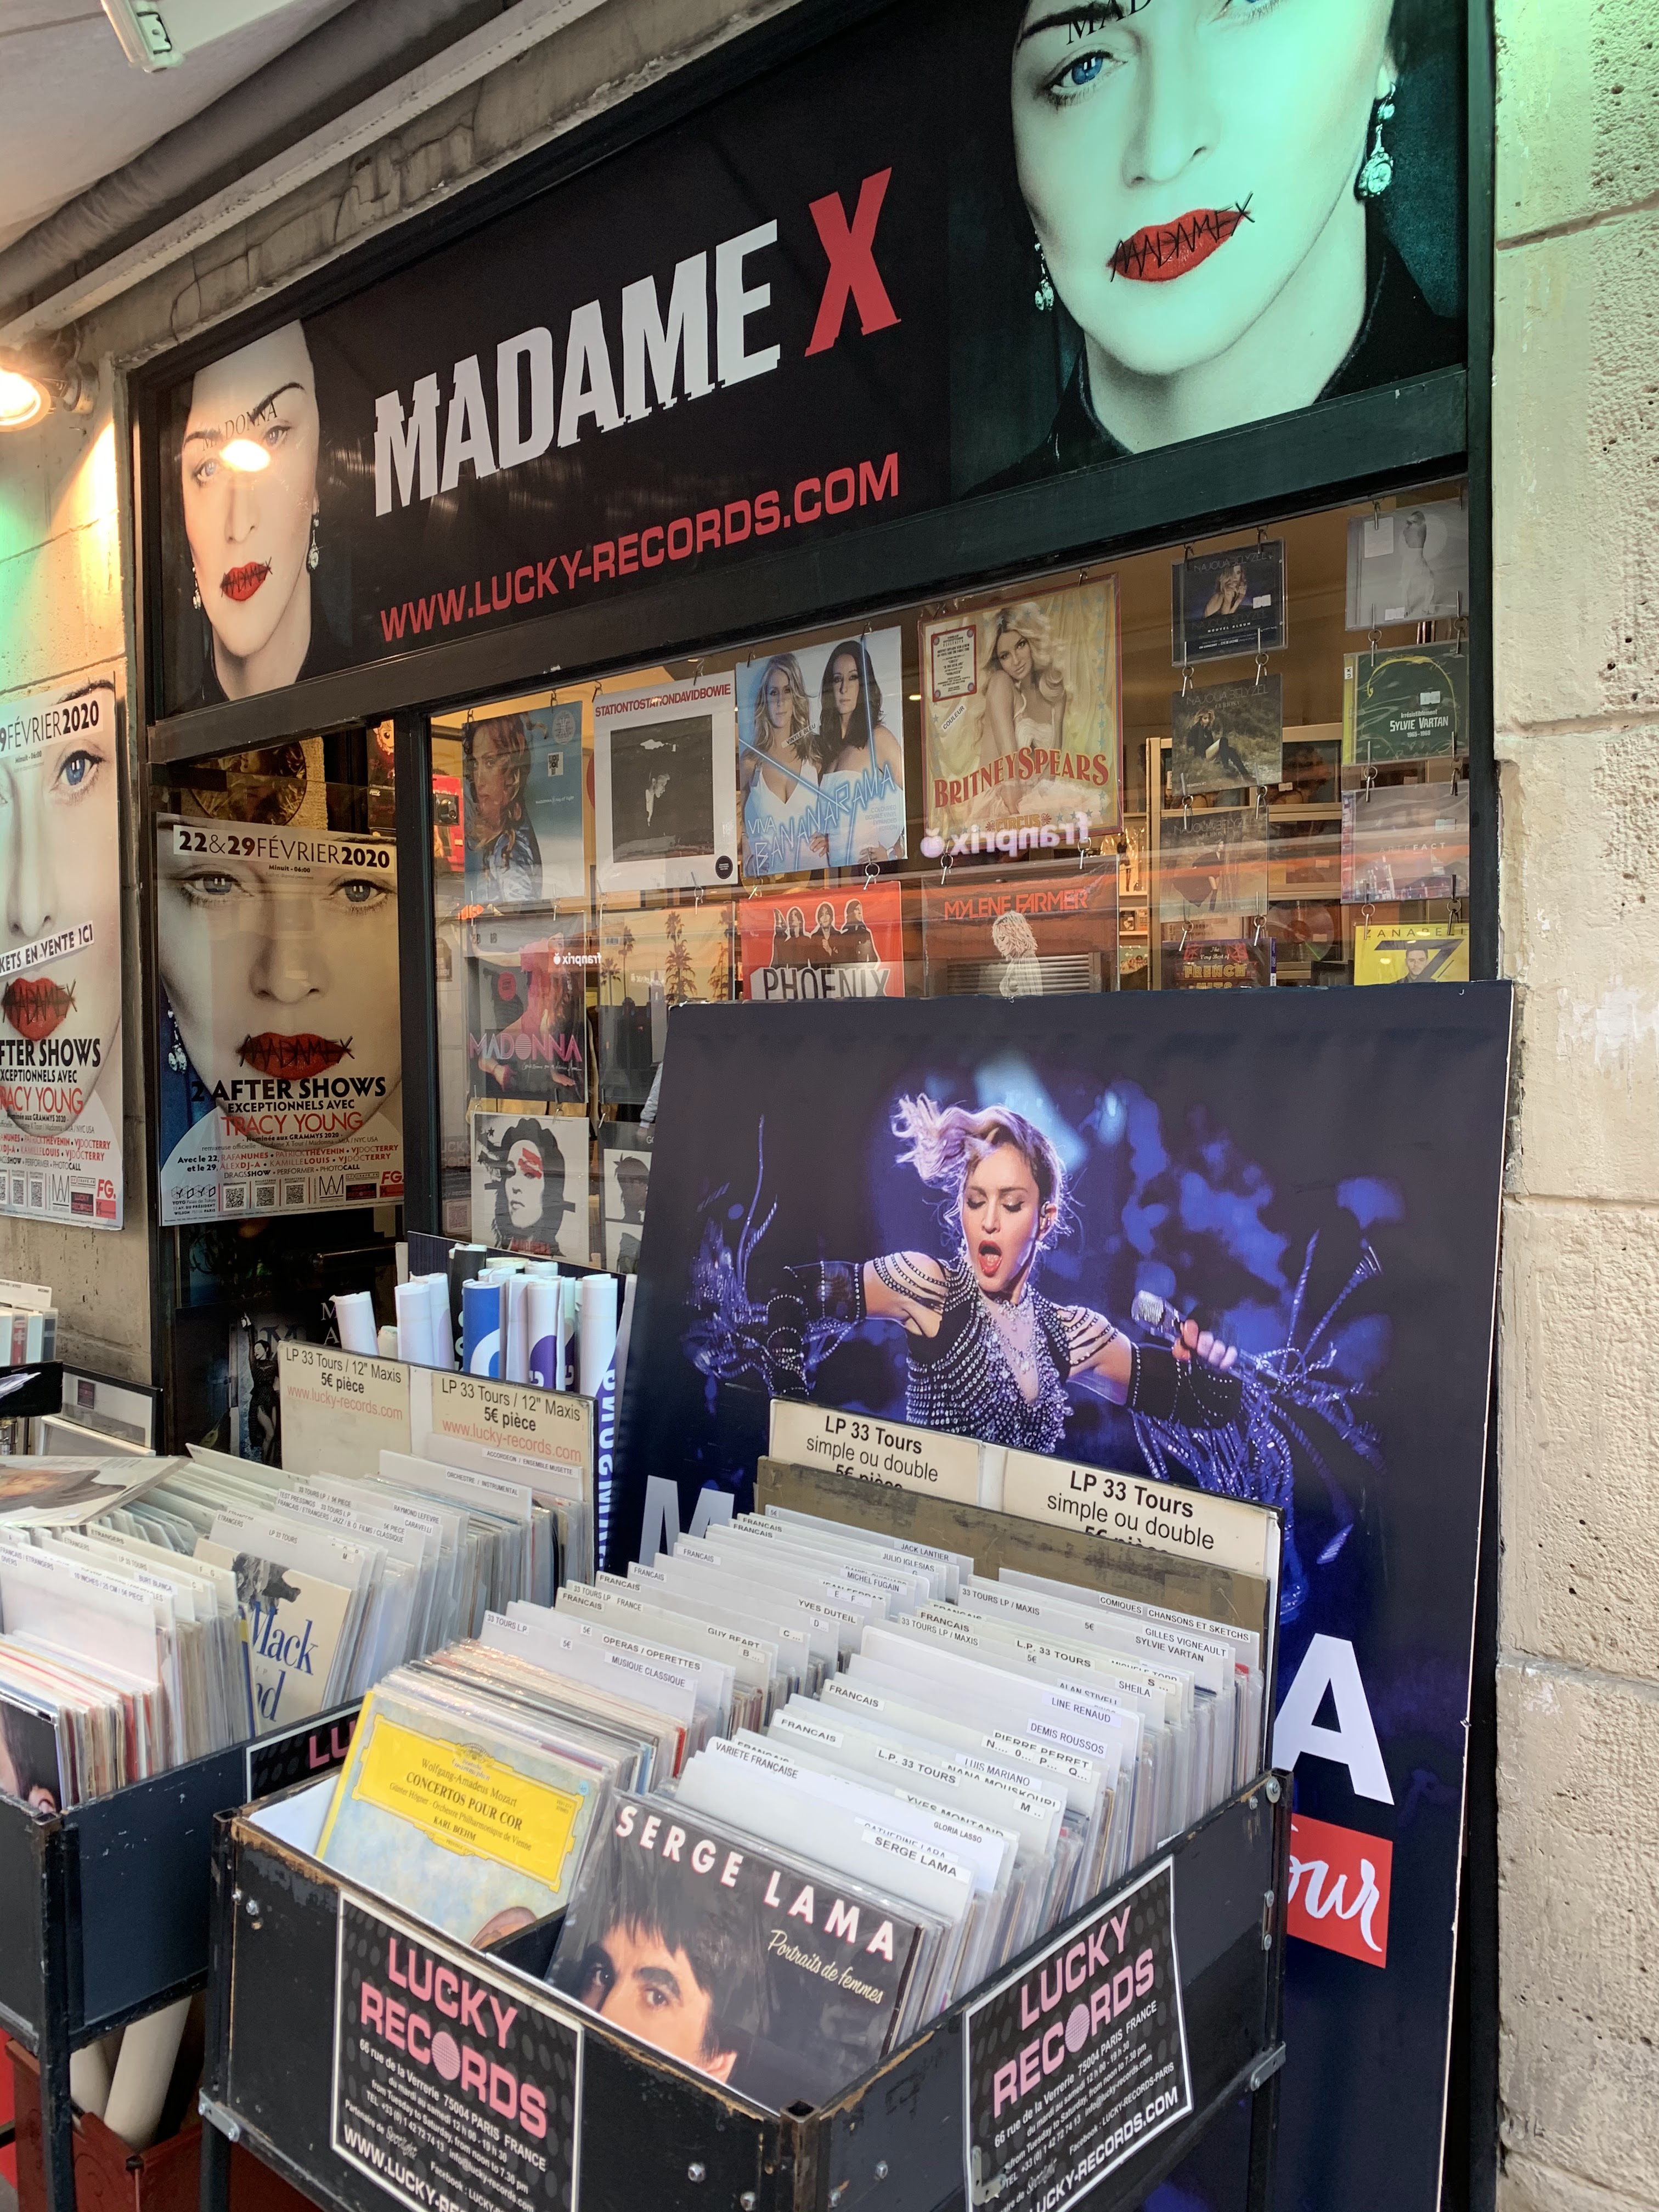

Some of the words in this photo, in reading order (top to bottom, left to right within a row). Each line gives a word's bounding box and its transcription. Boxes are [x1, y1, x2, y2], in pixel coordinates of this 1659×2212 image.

[374, 219, 780, 516] MADAME
[804, 167, 901, 357] X
[380, 452, 899, 642] WWW.LUCKY-RECORDS.COM
[942, 706, 966, 730] COULEUR
[1390, 720, 1416, 732] SYLVIE
[1419, 716, 1449, 729] VARTAN
[786, 731, 804, 744] VINYLE
[803, 724, 816, 735] BLEU
[748, 816, 776, 834] VIVA
[755, 763, 895, 877] BANANARAMA
[945, 895, 1011, 921] MYLENE
[1016, 888, 1088, 913] FARMER
[25, 945, 38, 964] EN
[41, 931, 75, 958] VENTE
[78, 924, 93, 945] ICI
[763, 967, 889, 998] PHOENIX
[1184, 964, 1248, 978] FRENCH
[39, 1039, 101, 1068] SHOWS
[470, 1032, 583, 1062] MADONNA
[57, 1070, 77, 1084] AVEC
[190, 1081, 205, 1103] 2
[211, 1078, 295, 1102] AFTER
[299, 1076, 386, 1098] SHOWS
[35, 1087, 83, 1115] YOUNG
[228, 1100, 324, 1114] EXCEPTIONNELS
[326, 1099, 355, 1110] AVEC
[221, 1114, 288, 1137] TRACY
[292, 1111, 364, 1133] YOUNG
[289, 1132, 323, 1141] GRAMMYS
[285, 1347, 300, 1363] LP
[302, 1350, 314, 1366] 33
[315, 1352, 344, 1373] Tours
[371, 1362, 402, 1384] Maxis
[320, 1373, 335, 1390] 5€
[336, 1375, 365, 1397] pièce
[286, 1383, 403, 1421] www.lucky-records.com
[441, 1378, 457, 1395] LP
[460, 1380, 475, 1400] 33
[477, 1384, 510, 1406] Tours
[544, 1397, 581, 1423] Maxis
[483, 1406, 499, 1425] 5€
[501, 1410, 537, 1434] pièce
[825, 1414, 847, 1435] LP
[850, 1418, 870, 1440] 33
[874, 1426, 923, 1455] Tours
[441, 1418, 583, 1464] www.lucky-records.com
[806, 1436, 855, 1465] simple
[859, 1451, 879, 1468] ou
[883, 1453, 939, 1483] double
[447, 1470, 476, 1485] ORCHESTRE
[481, 1478, 519, 1497] INSTRUMENTAL
[1070, 1470, 1097, 1494] LP
[1102, 1478, 1127, 1502] 33
[1133, 1485, 1195, 1519] Tours
[1047, 1492, 1109, 1523] simple
[1114, 1511, 1139, 1531] ou
[1144, 1515, 1215, 1550] double
[683, 1547, 715, 1564] FRANCAIS
[882, 1551, 902, 1565] JULIO
[902, 1556, 935, 1573] IGLESIAS
[901, 1543, 919, 1554] JACK
[920, 1547, 950, 1562] LANTIER
[599, 1573, 641, 1592] FRANCAIS
[634, 1566, 665, 1582] FRANCAIS
[847, 1571, 872, 1587] MICHEL
[873, 1577, 901, 1593] FUGAIN
[562, 1593, 603, 1611] FRANCAIS
[798, 1598, 821, 1613] YVES
[822, 1605, 857, 1624] DUTEIL
[920, 1610, 970, 1634] FRANCAIS
[1099, 1596, 1143, 1615] COMIQUES
[1148, 1608, 1195, 1629] CHANSONS
[1196, 1621, 1207, 1631] ET
[1208, 1623, 1250, 1642] SKETCHS
[603, 1635, 640, 1654] OPERAS
[646, 1647, 701, 1672] OPERETTES
[1135, 1635, 1166, 1652] SYLVIE
[1167, 1645, 1205, 1663] VARTAN
[1144, 1627, 1175, 1644] GILLES
[1177, 1635, 1228, 1658] VIGNEAULT
[611, 1655, 644, 1674] MUSIQUE
[645, 1666, 686, 1689] CLASSIQUE
[829, 1684, 880, 1708] FRANCAIS
[1118, 1680, 1152, 1699] SHEILA
[1051, 1697, 1072, 1711] LINE
[1073, 1703, 1111, 1724] RENAUD
[781, 1718, 837, 1743] FRANCAIS
[1030, 1722, 1058, 1740] DEMIS
[1059, 1731, 1104, 1755] ROUSSOS
[715, 1741, 749, 1763] VARIETE
[751, 1753, 799, 1780] FRANCAISE
[422, 1757, 489, 1795] Wolfgang-Amadeus
[490, 1788, 518, 1808] Mozart
[406, 1771, 467, 1807] CONCERTOS
[469, 1797, 498, 1821] POUR
[499, 1809, 523, 1832] COR
[933, 1820, 958, 1837] GLORIA
[959, 1829, 983, 1844] LASSO
[874, 1835, 918, 1861] SERGE
[919, 1853, 957, 1878] LAMA
[614, 1805, 744, 1888] SERGE
[763, 1870, 894, 1962] LAMA
[768, 1929, 822, 1975] Portraits
[821, 1961, 839, 1982] de
[837, 1967, 884, 2006] femmes
[1021, 1905, 1132, 2031] LUCKY
[388, 1937, 518, 2050] LUCKY
[993, 1948, 1155, 2119] RECORDS
[360, 1981, 548, 2140] RECORDS
[359, 2038, 370, 2051] 66
[370, 2046, 385, 2064] rue
[386, 2057, 396, 2072] de
[397, 2063, 406, 2079] la
[406, 2067, 440, 2103] Verrerie
[443, 2094, 471, 2122] 75004
[471, 2112, 500, 2142] PARIS
[504, 2134, 548, 2174] FRANCE
